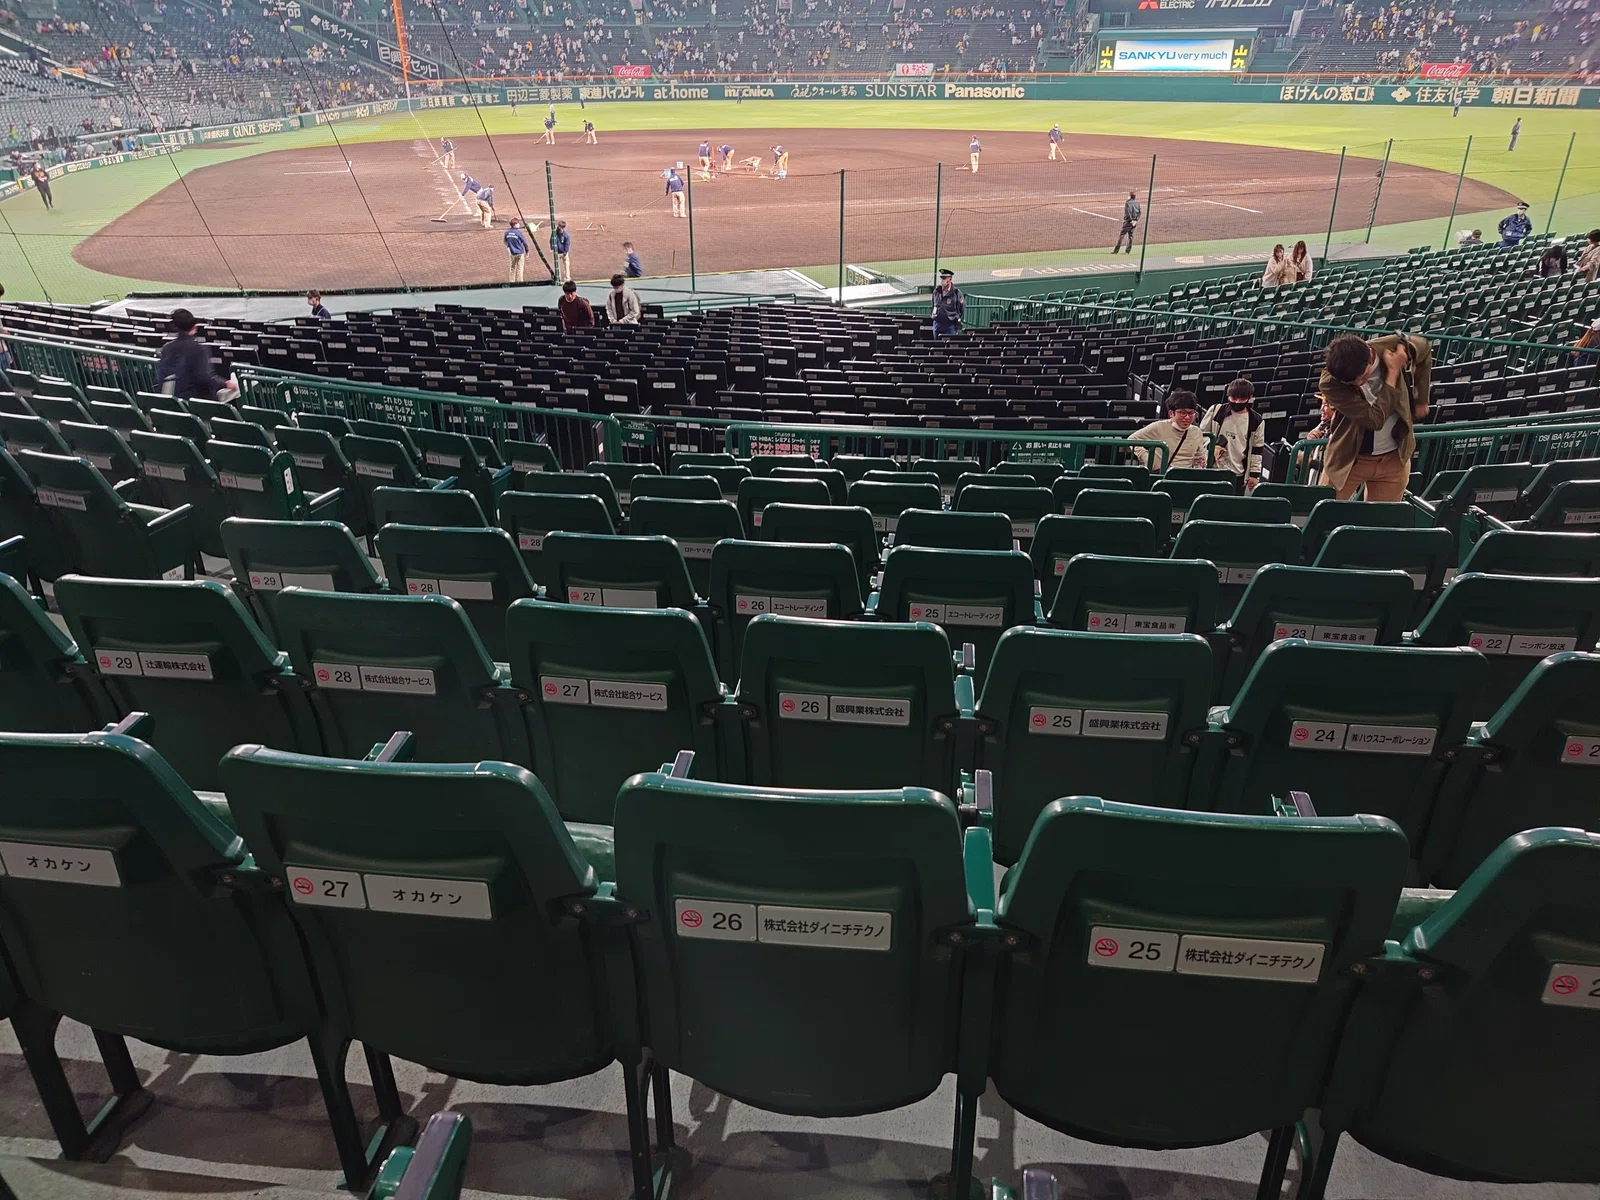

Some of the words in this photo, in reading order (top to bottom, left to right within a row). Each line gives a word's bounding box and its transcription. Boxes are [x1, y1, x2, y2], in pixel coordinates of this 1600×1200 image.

[1118, 51, 1176, 60] SANKYU
[1177, 52, 1200, 61] very
[1200, 50, 1228, 60] much
[506, 88, 573, 102] 田辺三菱製薬
[579, 86, 645, 100] 東進ハイスクール
[669, 84, 709, 99] home
[865, 84, 937, 97] SUNSTAR
[944, 83, 1025, 98] Panasonic
[1280, 86, 1369, 101] ほけんの窓口
[1416, 87, 1480, 103] 住友化学
[1491, 87, 1582, 106] 朝日新聞
[233, 123, 257, 138] GUNZE
[1030, 263, 1138, 275] idemitsu
[530, 539, 541, 547] 28
[264, 576, 276, 586] 29
[421, 583, 434, 593] 28
[583, 592, 596, 602] 27
[751, 600, 765, 611] 26
[773, 603, 825, 613] エコートレーディング
[925, 608, 939, 618] 25
[948, 610, 1001, 621] エコートレーディング
[1104, 618, 1119, 628] 24
[1291, 629, 1307, 639] 23
[1486, 638, 1502, 649] 22
[1519, 641, 1567, 651] ニッポン放送
[115, 657, 133, 669] 29
[334, 670, 352, 683] 28
[364, 674, 432, 687] 株式会社総合サービス
[562, 684, 580, 697] 27
[594, 688, 664, 702] 株式会社総合サービス
[801, 700, 820, 714] 26
[835, 704, 905, 717] 盛興業株式会社
[1052, 715, 1072, 728] 25
[1088, 718, 1161, 731] 盛興業株式会社
[1314, 729, 1336, 743] 24
[1589, 744, 1600, 757] 2
[26, 855, 91, 873] オカケン
[321, 880, 350, 899] 27
[392, 889, 463, 906] オカケン
[711, 911, 743, 932] 26
[763, 917, 885, 938] 株式会社ダイニチテクノ
[1127, 940, 1162, 960] 25
[1185, 947, 1316, 970] 株式会社ダイニチテクノ
[1588, 978, 1600, 998] 2
